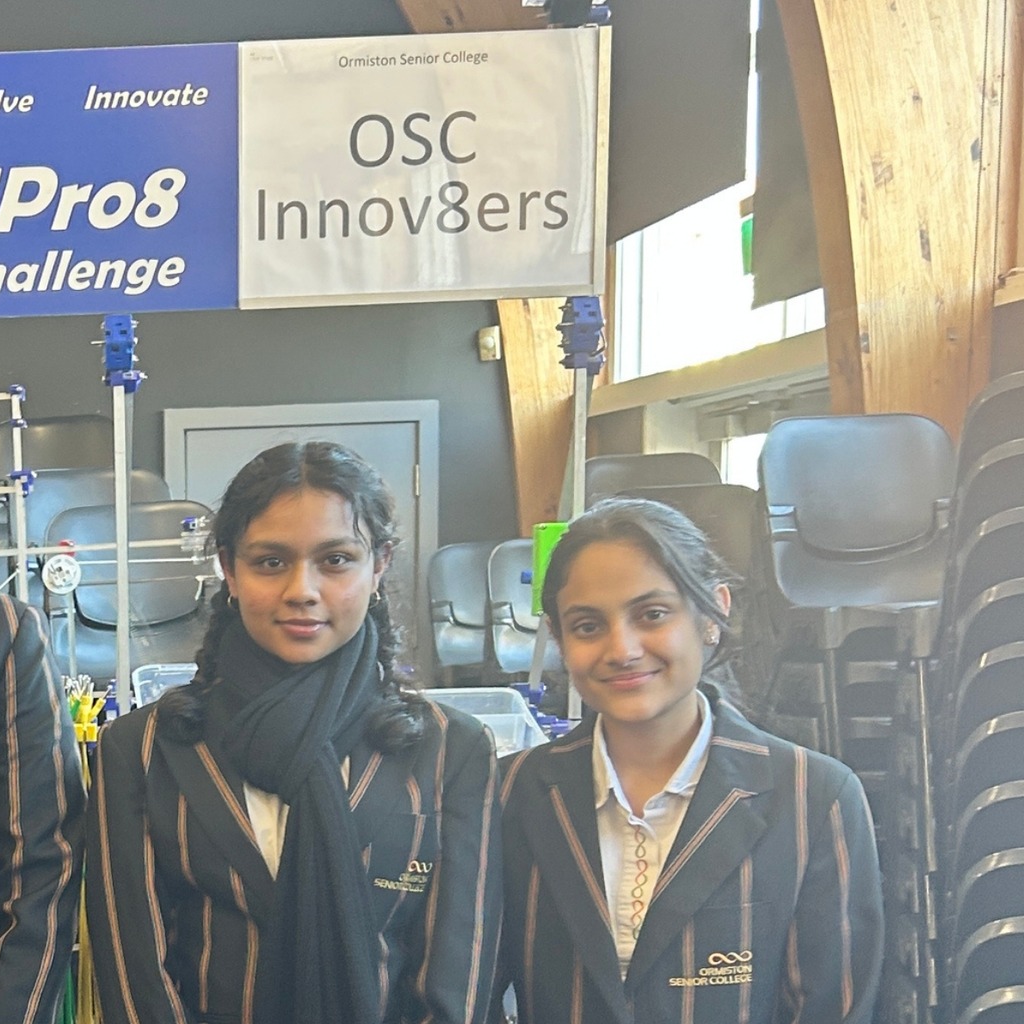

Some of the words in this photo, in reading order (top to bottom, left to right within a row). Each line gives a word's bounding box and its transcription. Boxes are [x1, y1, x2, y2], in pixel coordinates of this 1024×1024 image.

[338, 54, 397, 68] Ormiston
[399, 53, 440, 66] Senior
[442, 50, 489, 65] College
[83, 84, 209, 111] Innovate
[349, 111, 477, 168] OSC
[257, 180, 569, 241] Innov8ers
[669, 977, 708, 987] SENIOR
[709, 973, 753, 985] COLLEGE
[699, 964, 753, 976] ORMISTON
